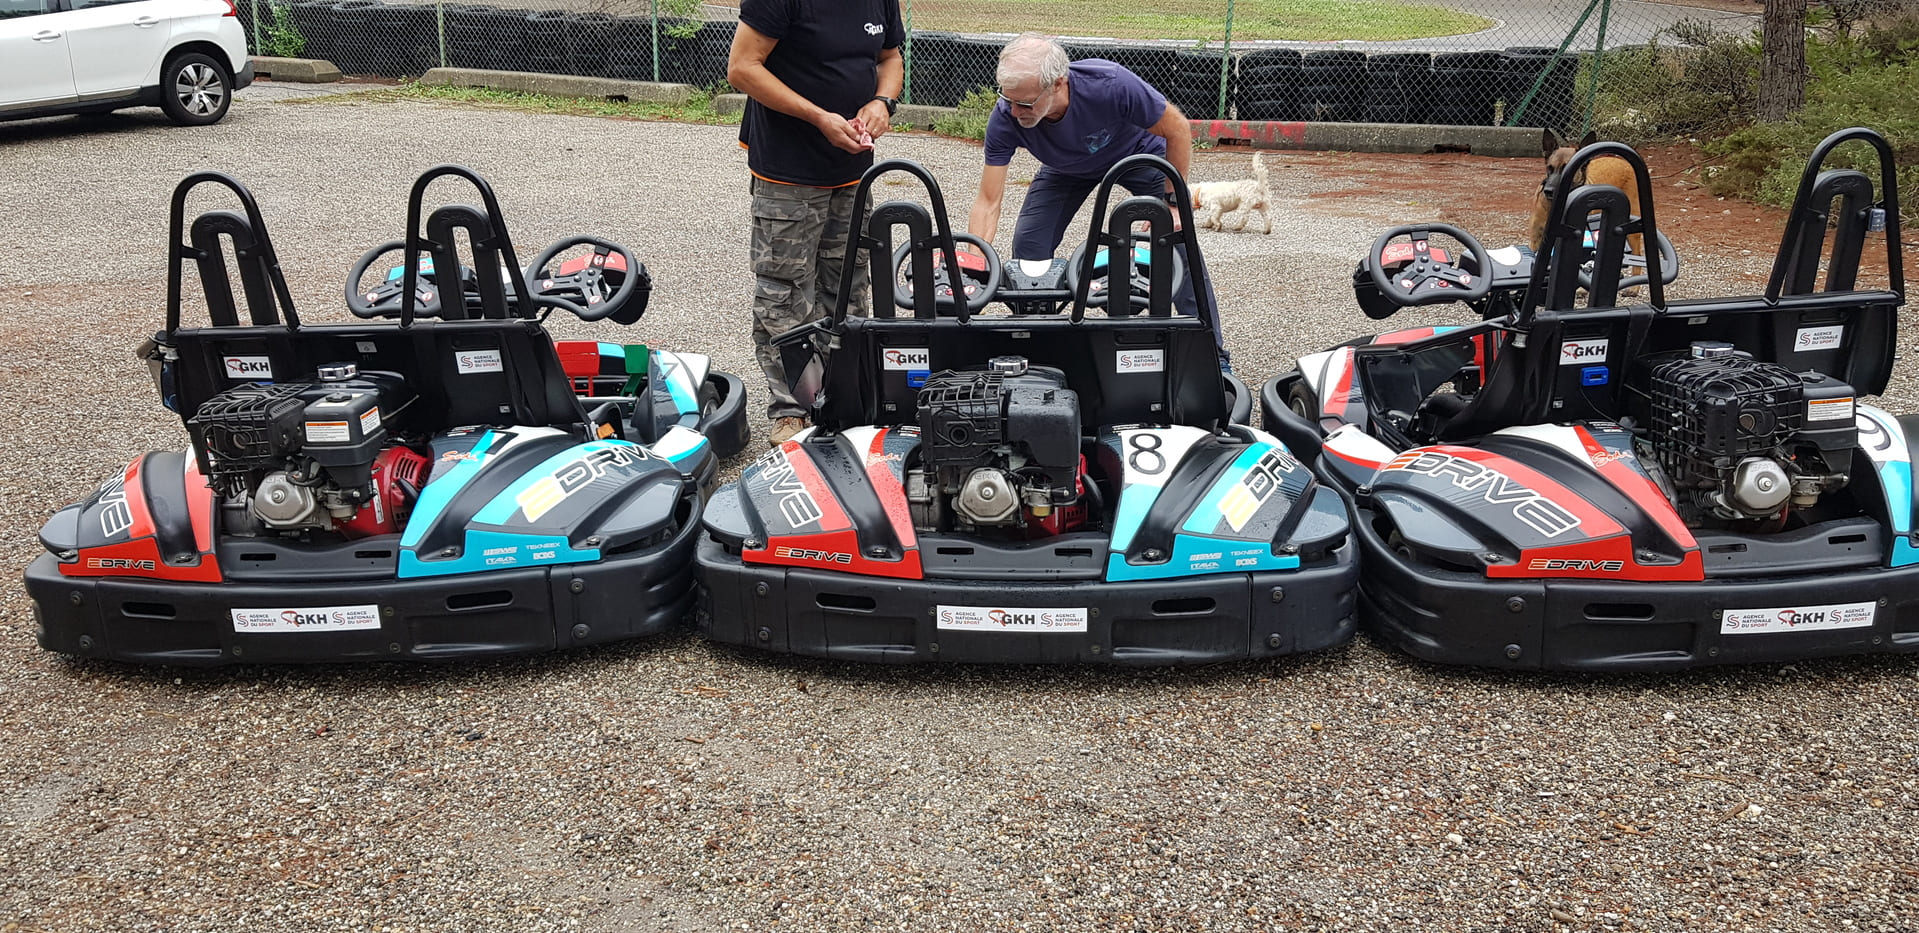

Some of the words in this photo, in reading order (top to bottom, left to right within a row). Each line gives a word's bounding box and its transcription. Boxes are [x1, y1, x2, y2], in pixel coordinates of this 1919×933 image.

[1575, 345, 1606, 357] GKH
[897, 354, 927, 364] GKH
[240, 362, 270, 371] GKH
[1129, 433, 1166, 475] 8
[295, 614, 328, 625] GKH
[1002, 614, 1035, 625] GKH
[1791, 612, 1825, 624] GKH
